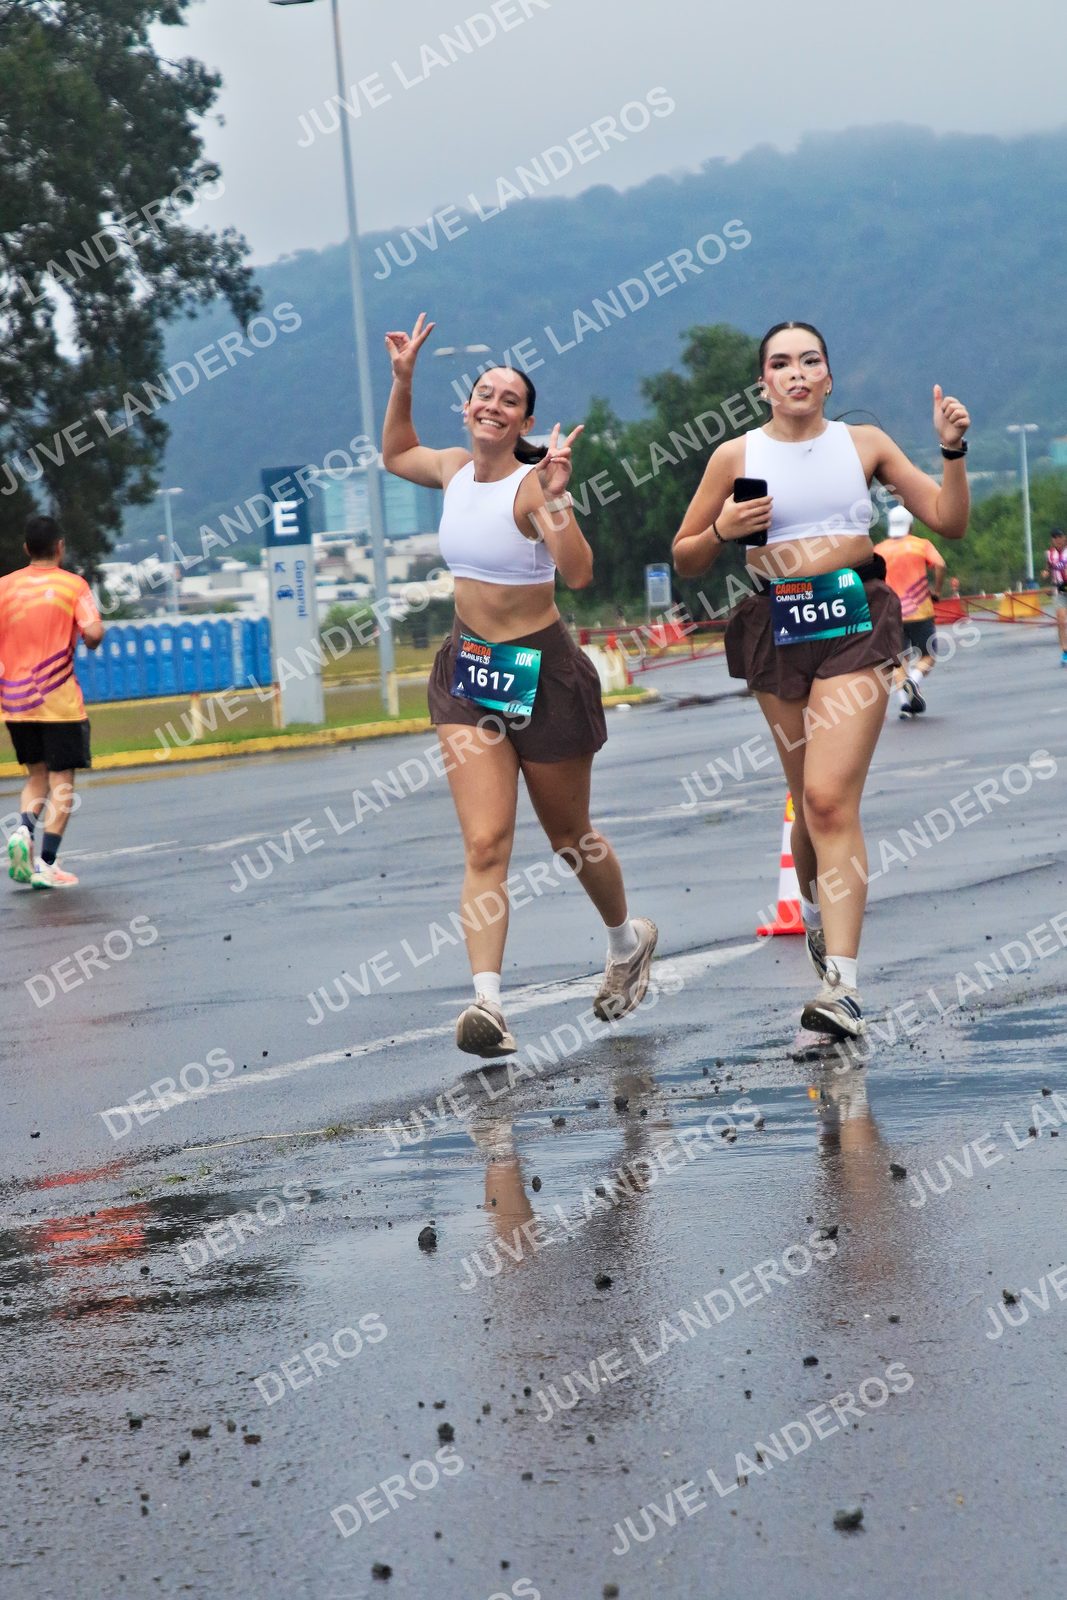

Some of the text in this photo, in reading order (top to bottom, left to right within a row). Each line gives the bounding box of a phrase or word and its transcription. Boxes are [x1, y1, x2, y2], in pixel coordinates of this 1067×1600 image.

[273, 501, 299, 535] E
[775, 582, 813, 595] CARRERA
[838, 572, 855, 589] 10K
[788, 598, 847, 624] 1616
[514, 652, 535, 667] 10K
[467, 665, 515, 692] 1617
